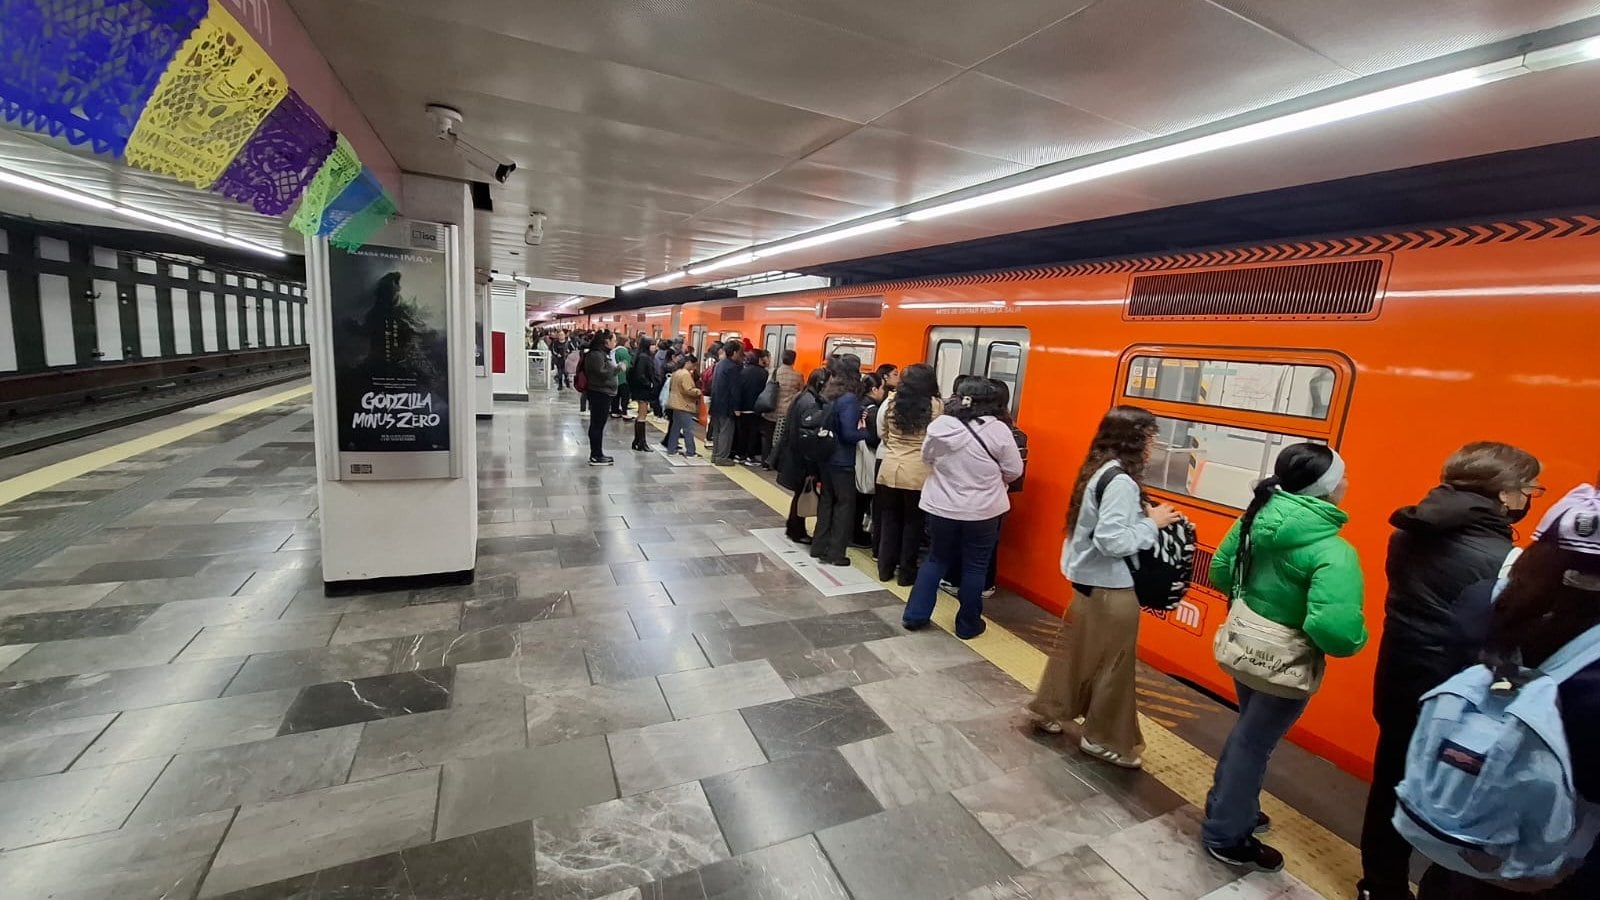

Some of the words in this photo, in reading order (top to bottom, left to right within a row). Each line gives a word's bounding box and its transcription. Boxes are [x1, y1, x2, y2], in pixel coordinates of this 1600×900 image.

[401, 254, 433, 264] IMAX
[361, 392, 432, 412] GODZILLA
[352, 412, 396, 429] MINUS
[396, 411, 441, 428] ZERO
